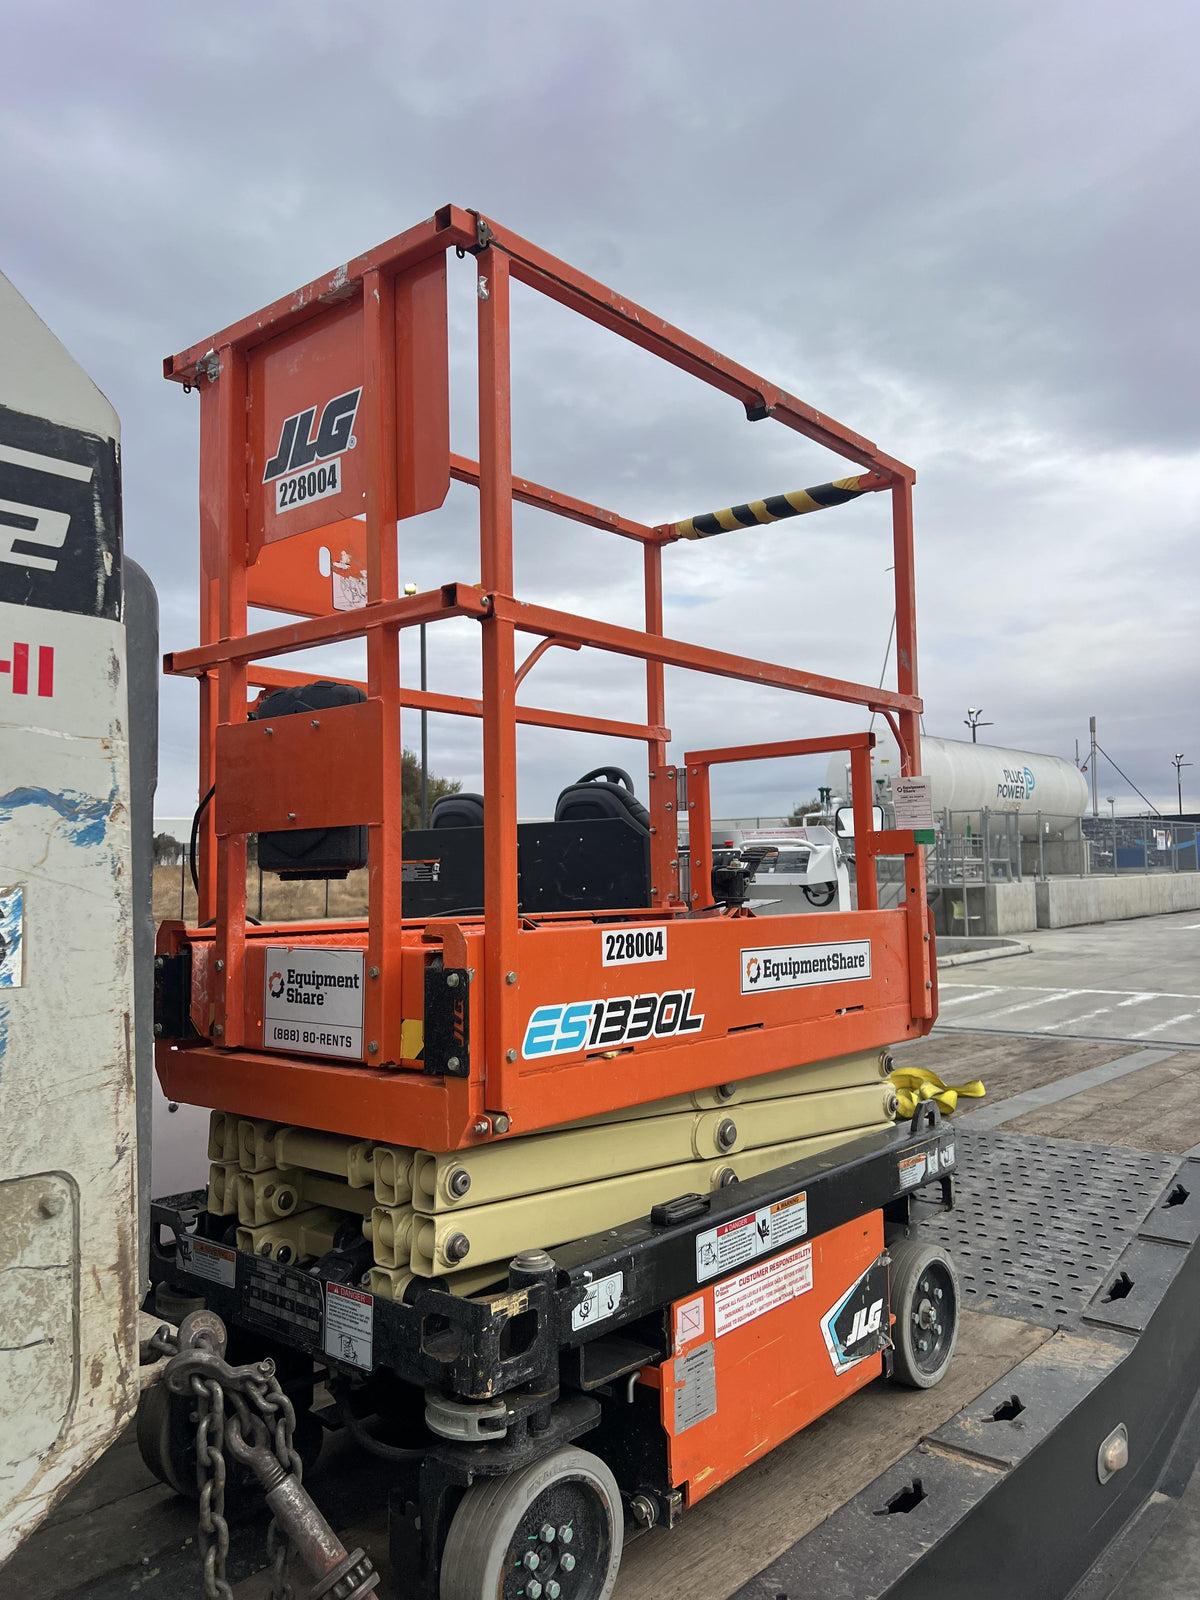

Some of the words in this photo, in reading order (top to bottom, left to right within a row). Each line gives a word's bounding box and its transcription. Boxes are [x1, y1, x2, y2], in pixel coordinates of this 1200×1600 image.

[264, 387, 362, 483] JLG
[279, 463, 337, 508] 228004
[1003, 769, 1024, 784] PLUG
[996, 783, 1025, 799] POWER
[605, 931, 664, 961] 228004
[763, 954, 866, 979] EquipmentShare
[286, 969, 360, 990] Equipment
[286, 987, 325, 1006] Share
[523, 990, 704, 1058] ES1330L
[273, 1026, 300, 1043] (888)
[302, 1030, 352, 1048] 80-RENTS
[728, 1217, 748, 1232] DANGER
[738, 1266, 769, 1287] CUSTOMER
[769, 1247, 811, 1273] RESPONSIBILITY
[340, 1287, 366, 1303] DANGER
[846, 1298, 884, 1347] JLG
